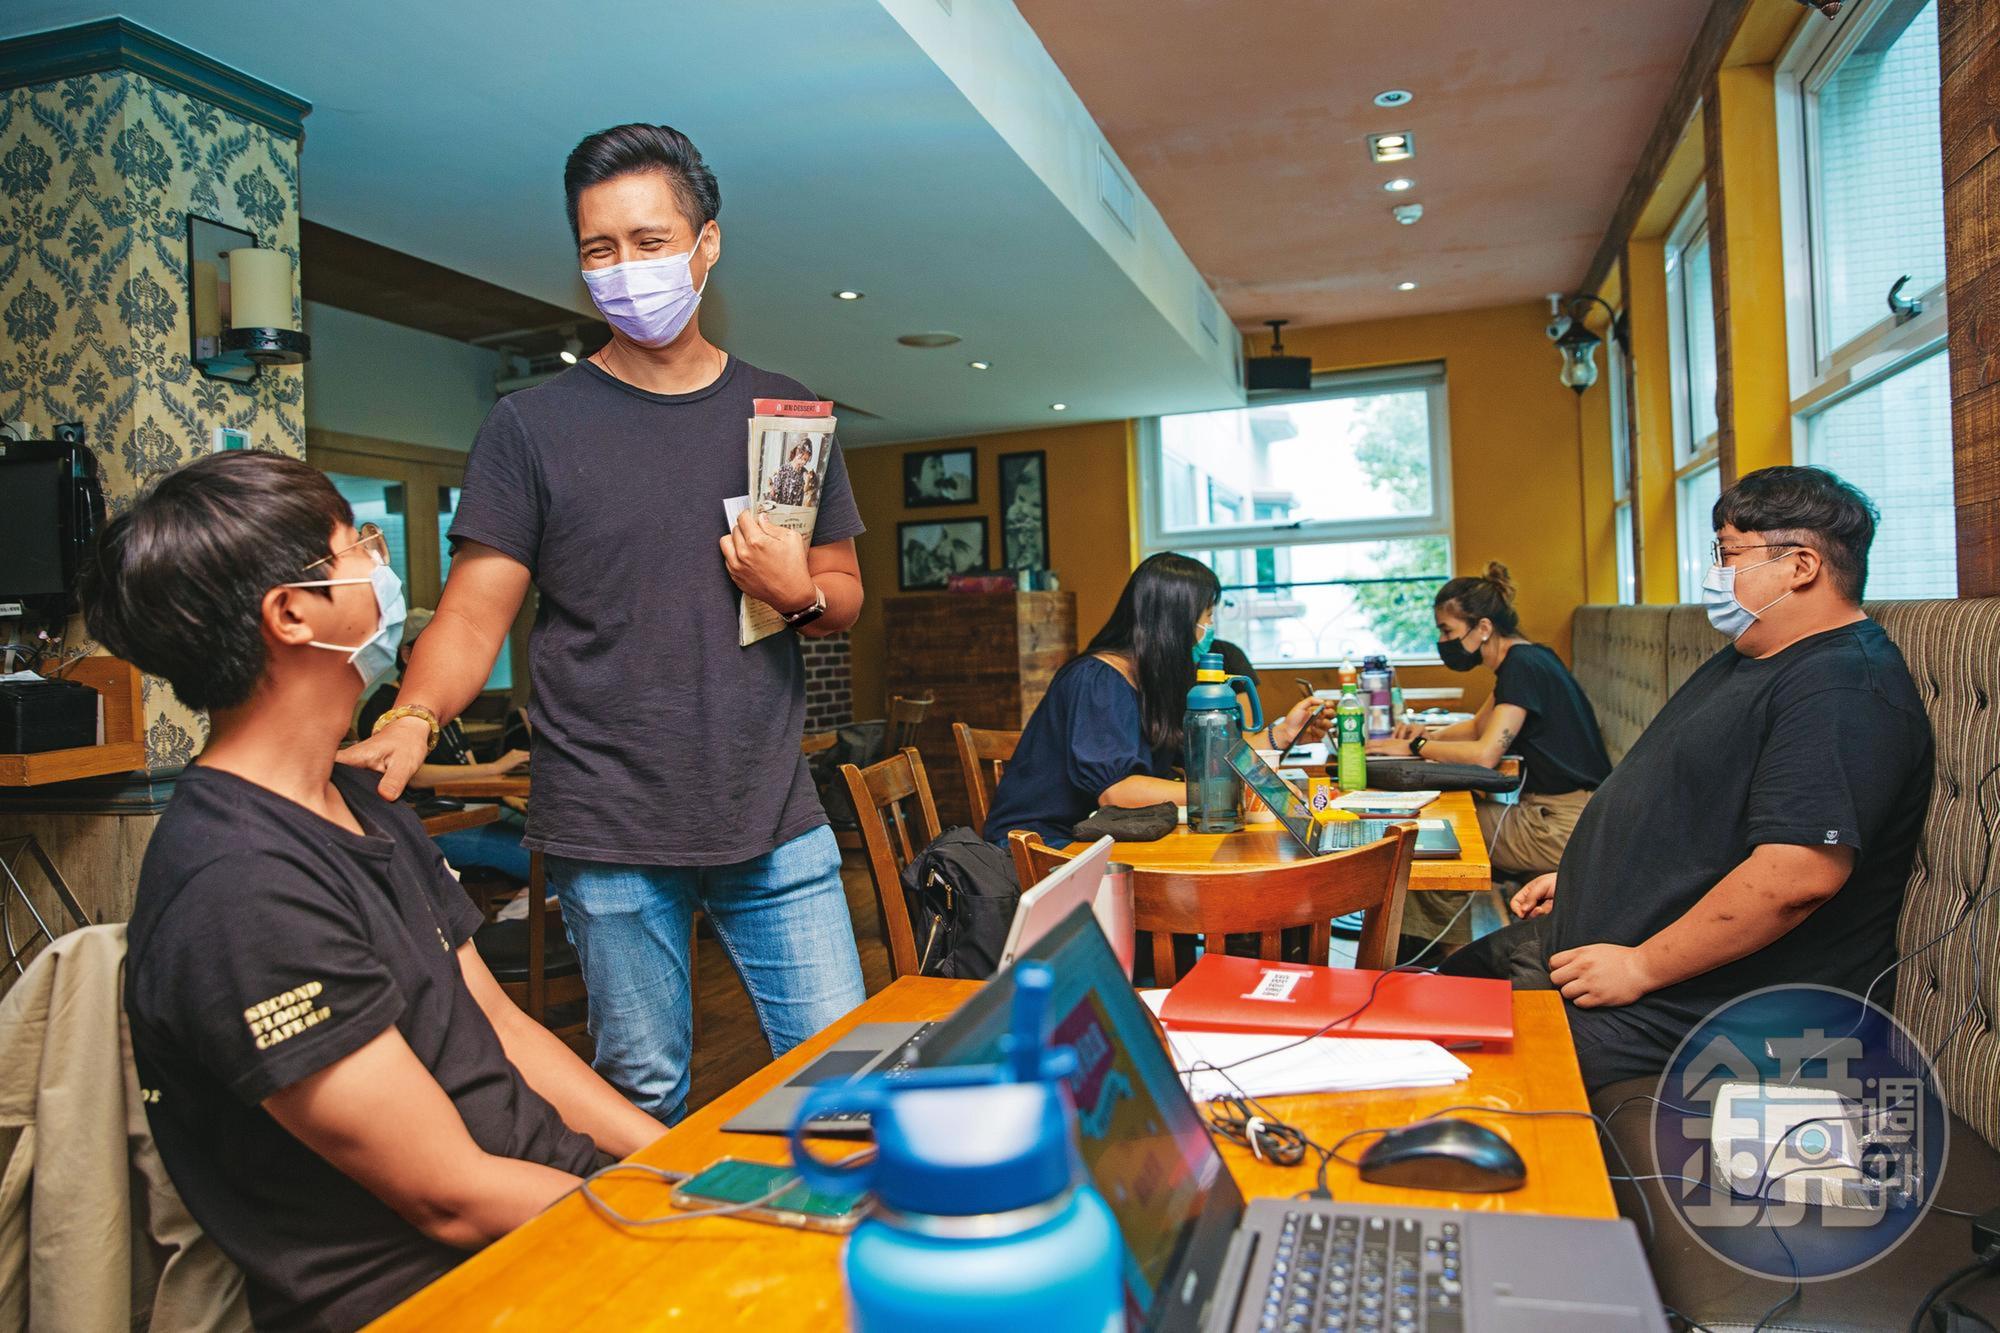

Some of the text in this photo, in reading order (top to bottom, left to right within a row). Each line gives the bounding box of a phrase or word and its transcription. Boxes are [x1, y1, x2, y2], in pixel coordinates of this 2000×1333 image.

[244, 981, 323, 1024] SECOND
[249, 999, 314, 1037] FLOOR
[256, 1017, 307, 1050] CAFE
